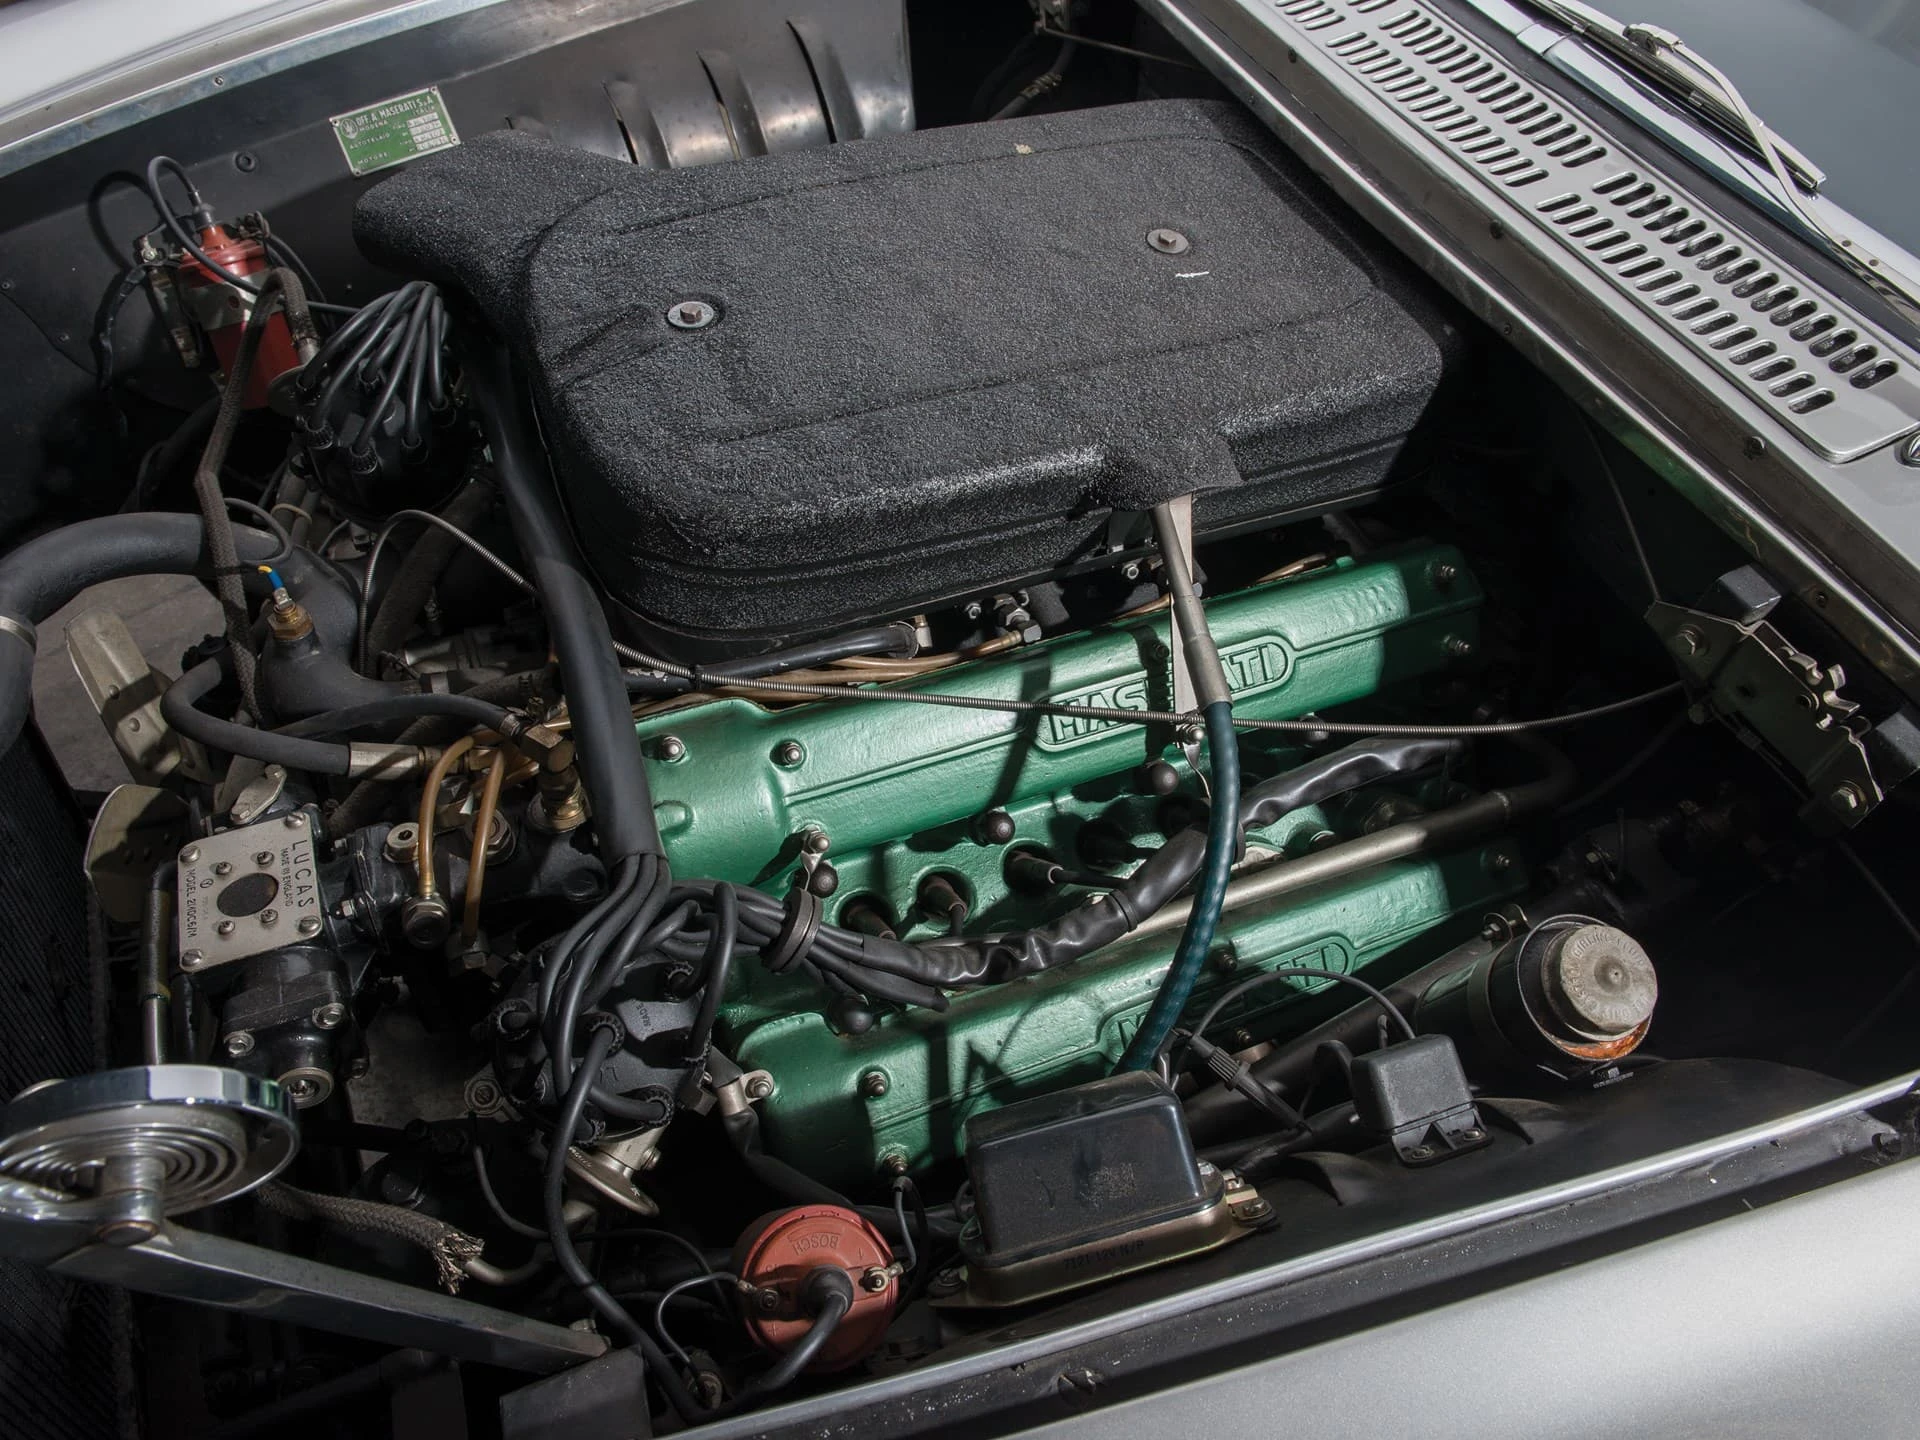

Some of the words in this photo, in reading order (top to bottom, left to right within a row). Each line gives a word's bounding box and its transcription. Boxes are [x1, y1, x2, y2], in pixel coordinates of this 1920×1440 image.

[379, 100, 417, 119] MASERATI
[359, 120, 389, 132] MODENA
[358, 152, 388, 165] MOTORE
[280, 848, 290, 867] MADE
[186, 868, 197, 898] MODEL
[292, 839, 315, 908] LUCAS
[282, 874, 294, 908] ENGLAND
[791, 1233, 841, 1257] BOSCH
